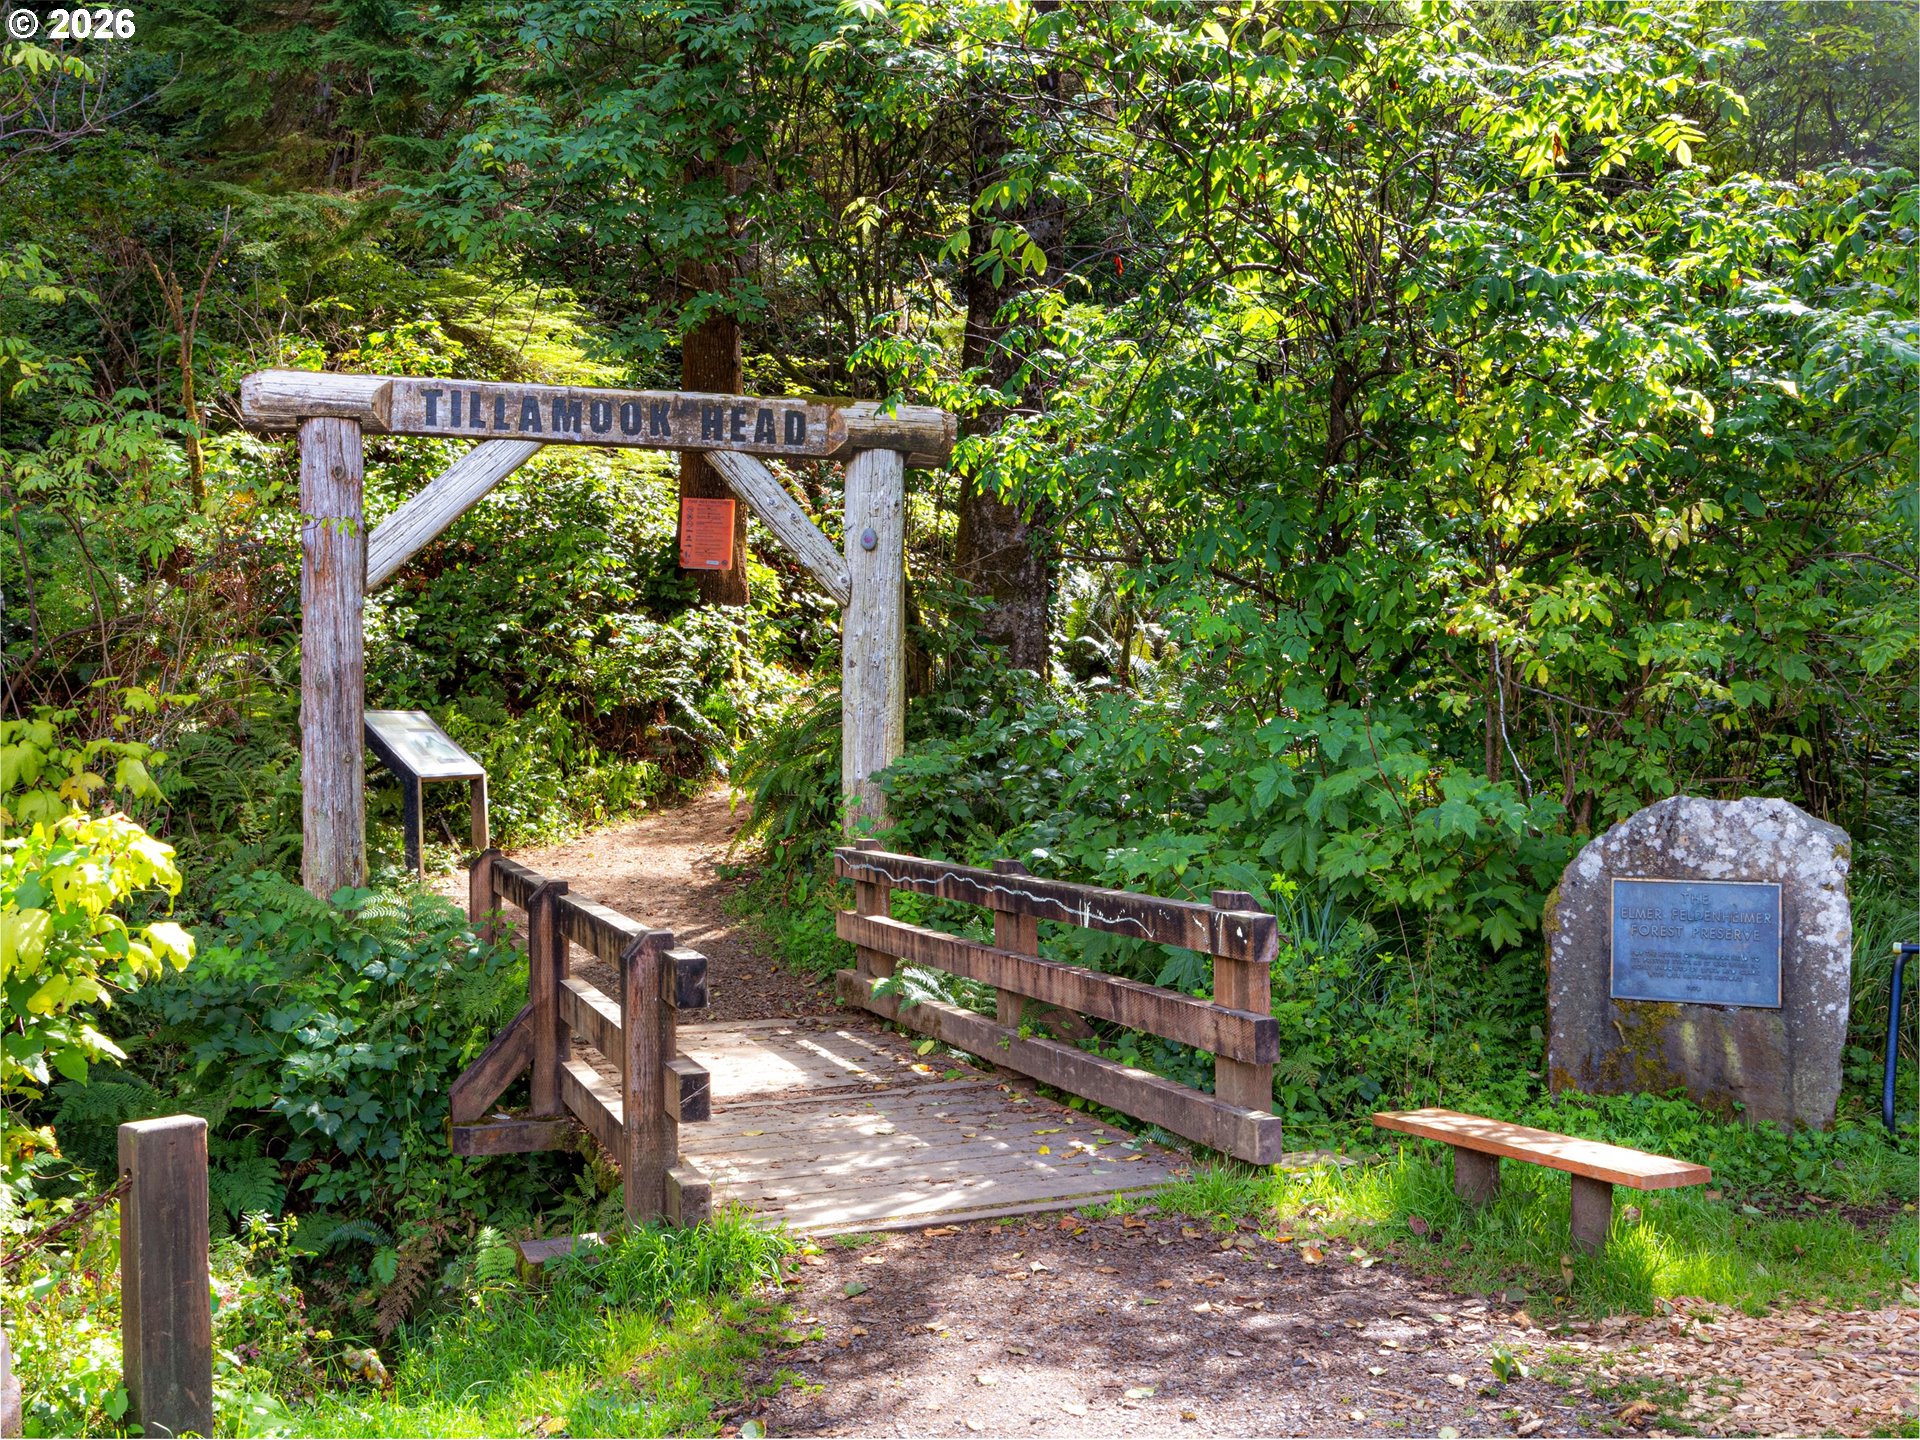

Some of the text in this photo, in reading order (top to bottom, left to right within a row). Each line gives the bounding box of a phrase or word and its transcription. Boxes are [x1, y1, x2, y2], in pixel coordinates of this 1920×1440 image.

[420, 388, 807, 446] TILLAMOOK HEAD
[1681, 892, 1710, 905] THE
[1621, 907, 1772, 924] ELMER FELDENHEIMER
[1631, 924, 1761, 941] FOREST PRESERVE
